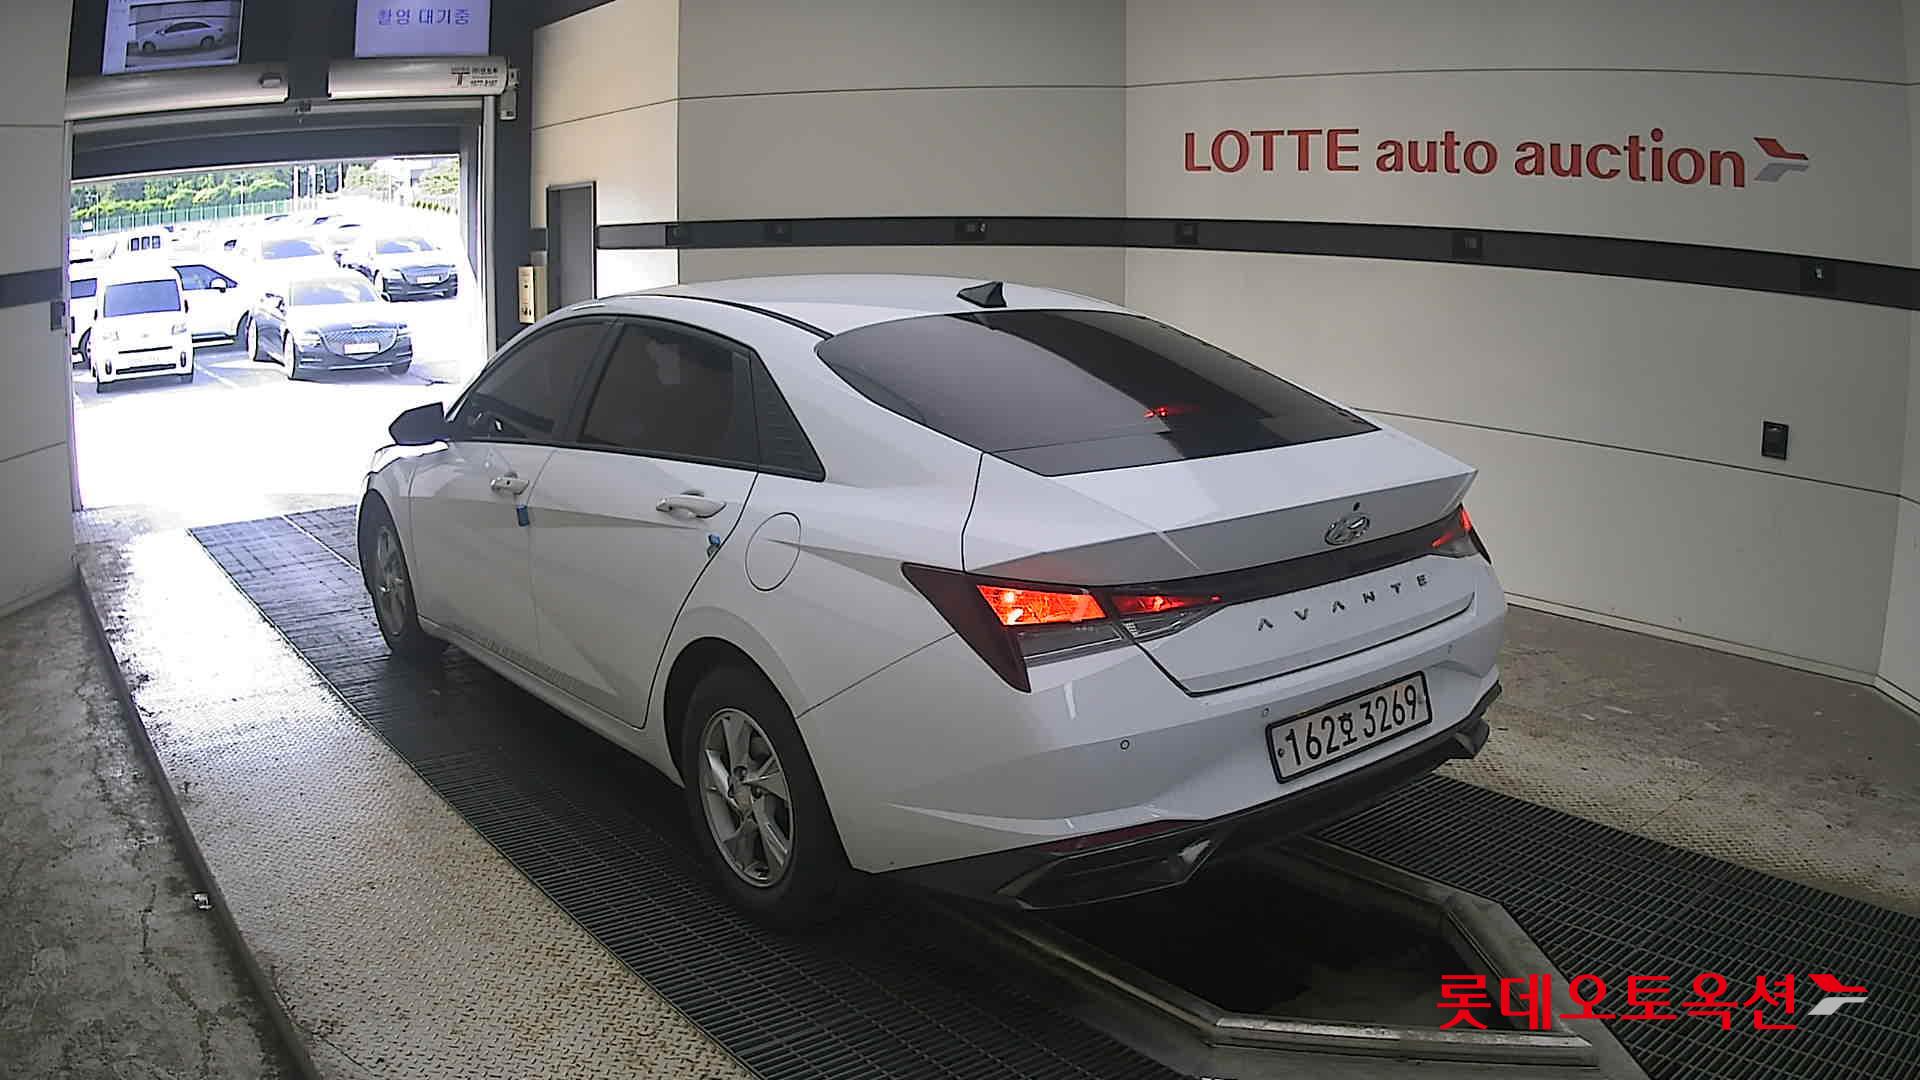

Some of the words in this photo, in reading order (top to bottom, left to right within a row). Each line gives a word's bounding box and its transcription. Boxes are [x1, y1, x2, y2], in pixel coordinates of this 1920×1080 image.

[419, 7, 470, 25] 대기중
[1184, 128, 1359, 173] LOTTE
[1376, 131, 1499, 175] auto
[1515, 130, 1745, 187] auction
[1257, 573, 1428, 631] AVANTE
[1285, 712, 1358, 766] 162호
[1359, 684, 1417, 739] 3269
